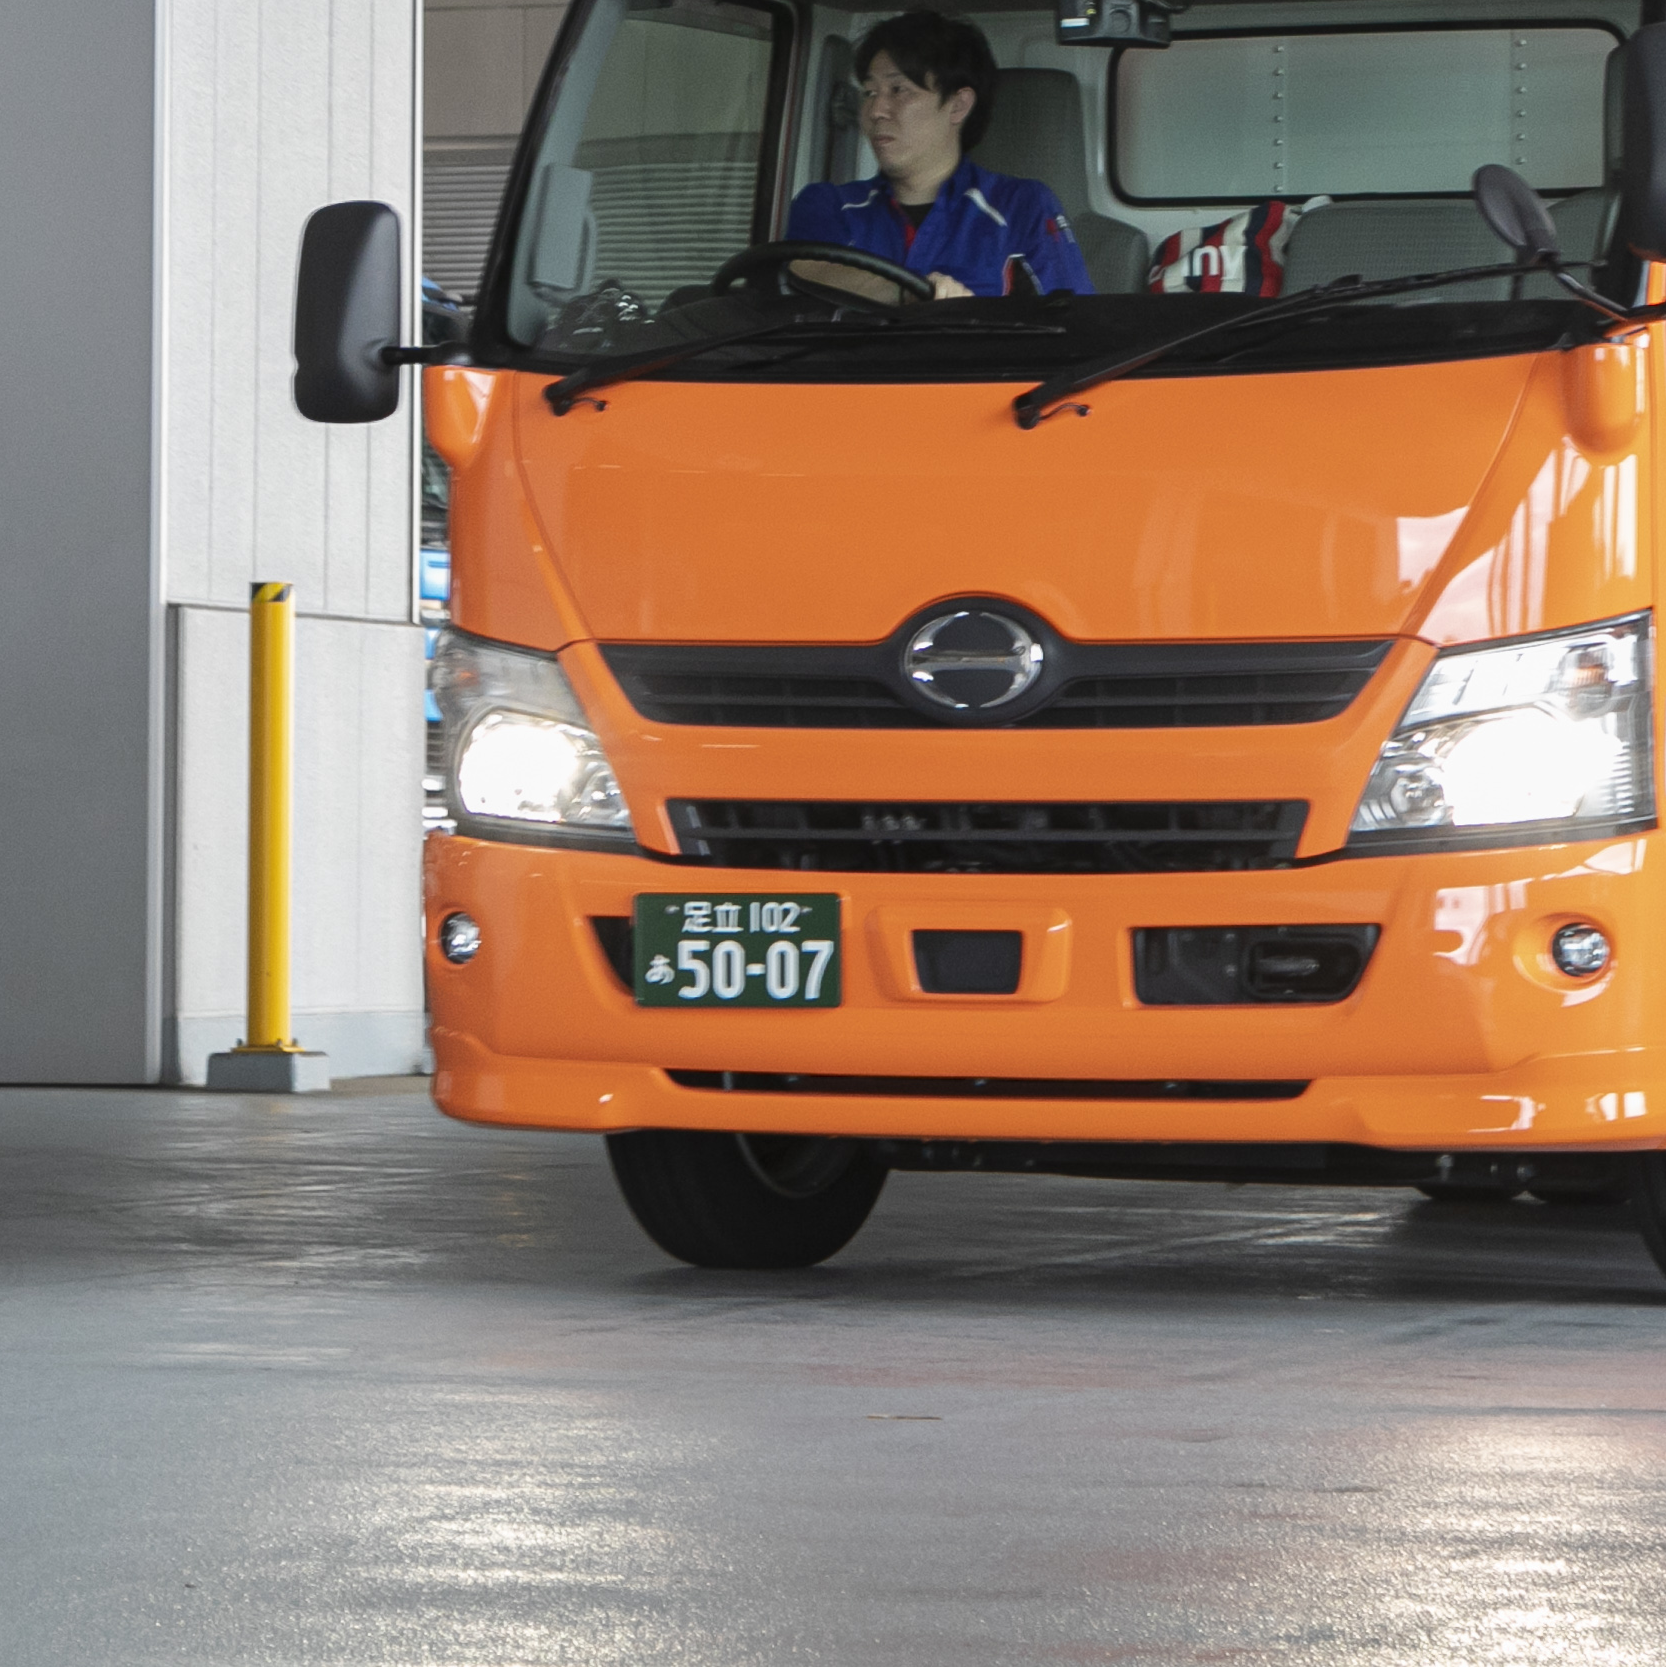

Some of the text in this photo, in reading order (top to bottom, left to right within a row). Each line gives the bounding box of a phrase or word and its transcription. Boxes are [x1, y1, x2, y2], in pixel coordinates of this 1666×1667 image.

[681, 901, 802, 933] 足立 102
[644, 939, 835, 1000] あ 50-07
